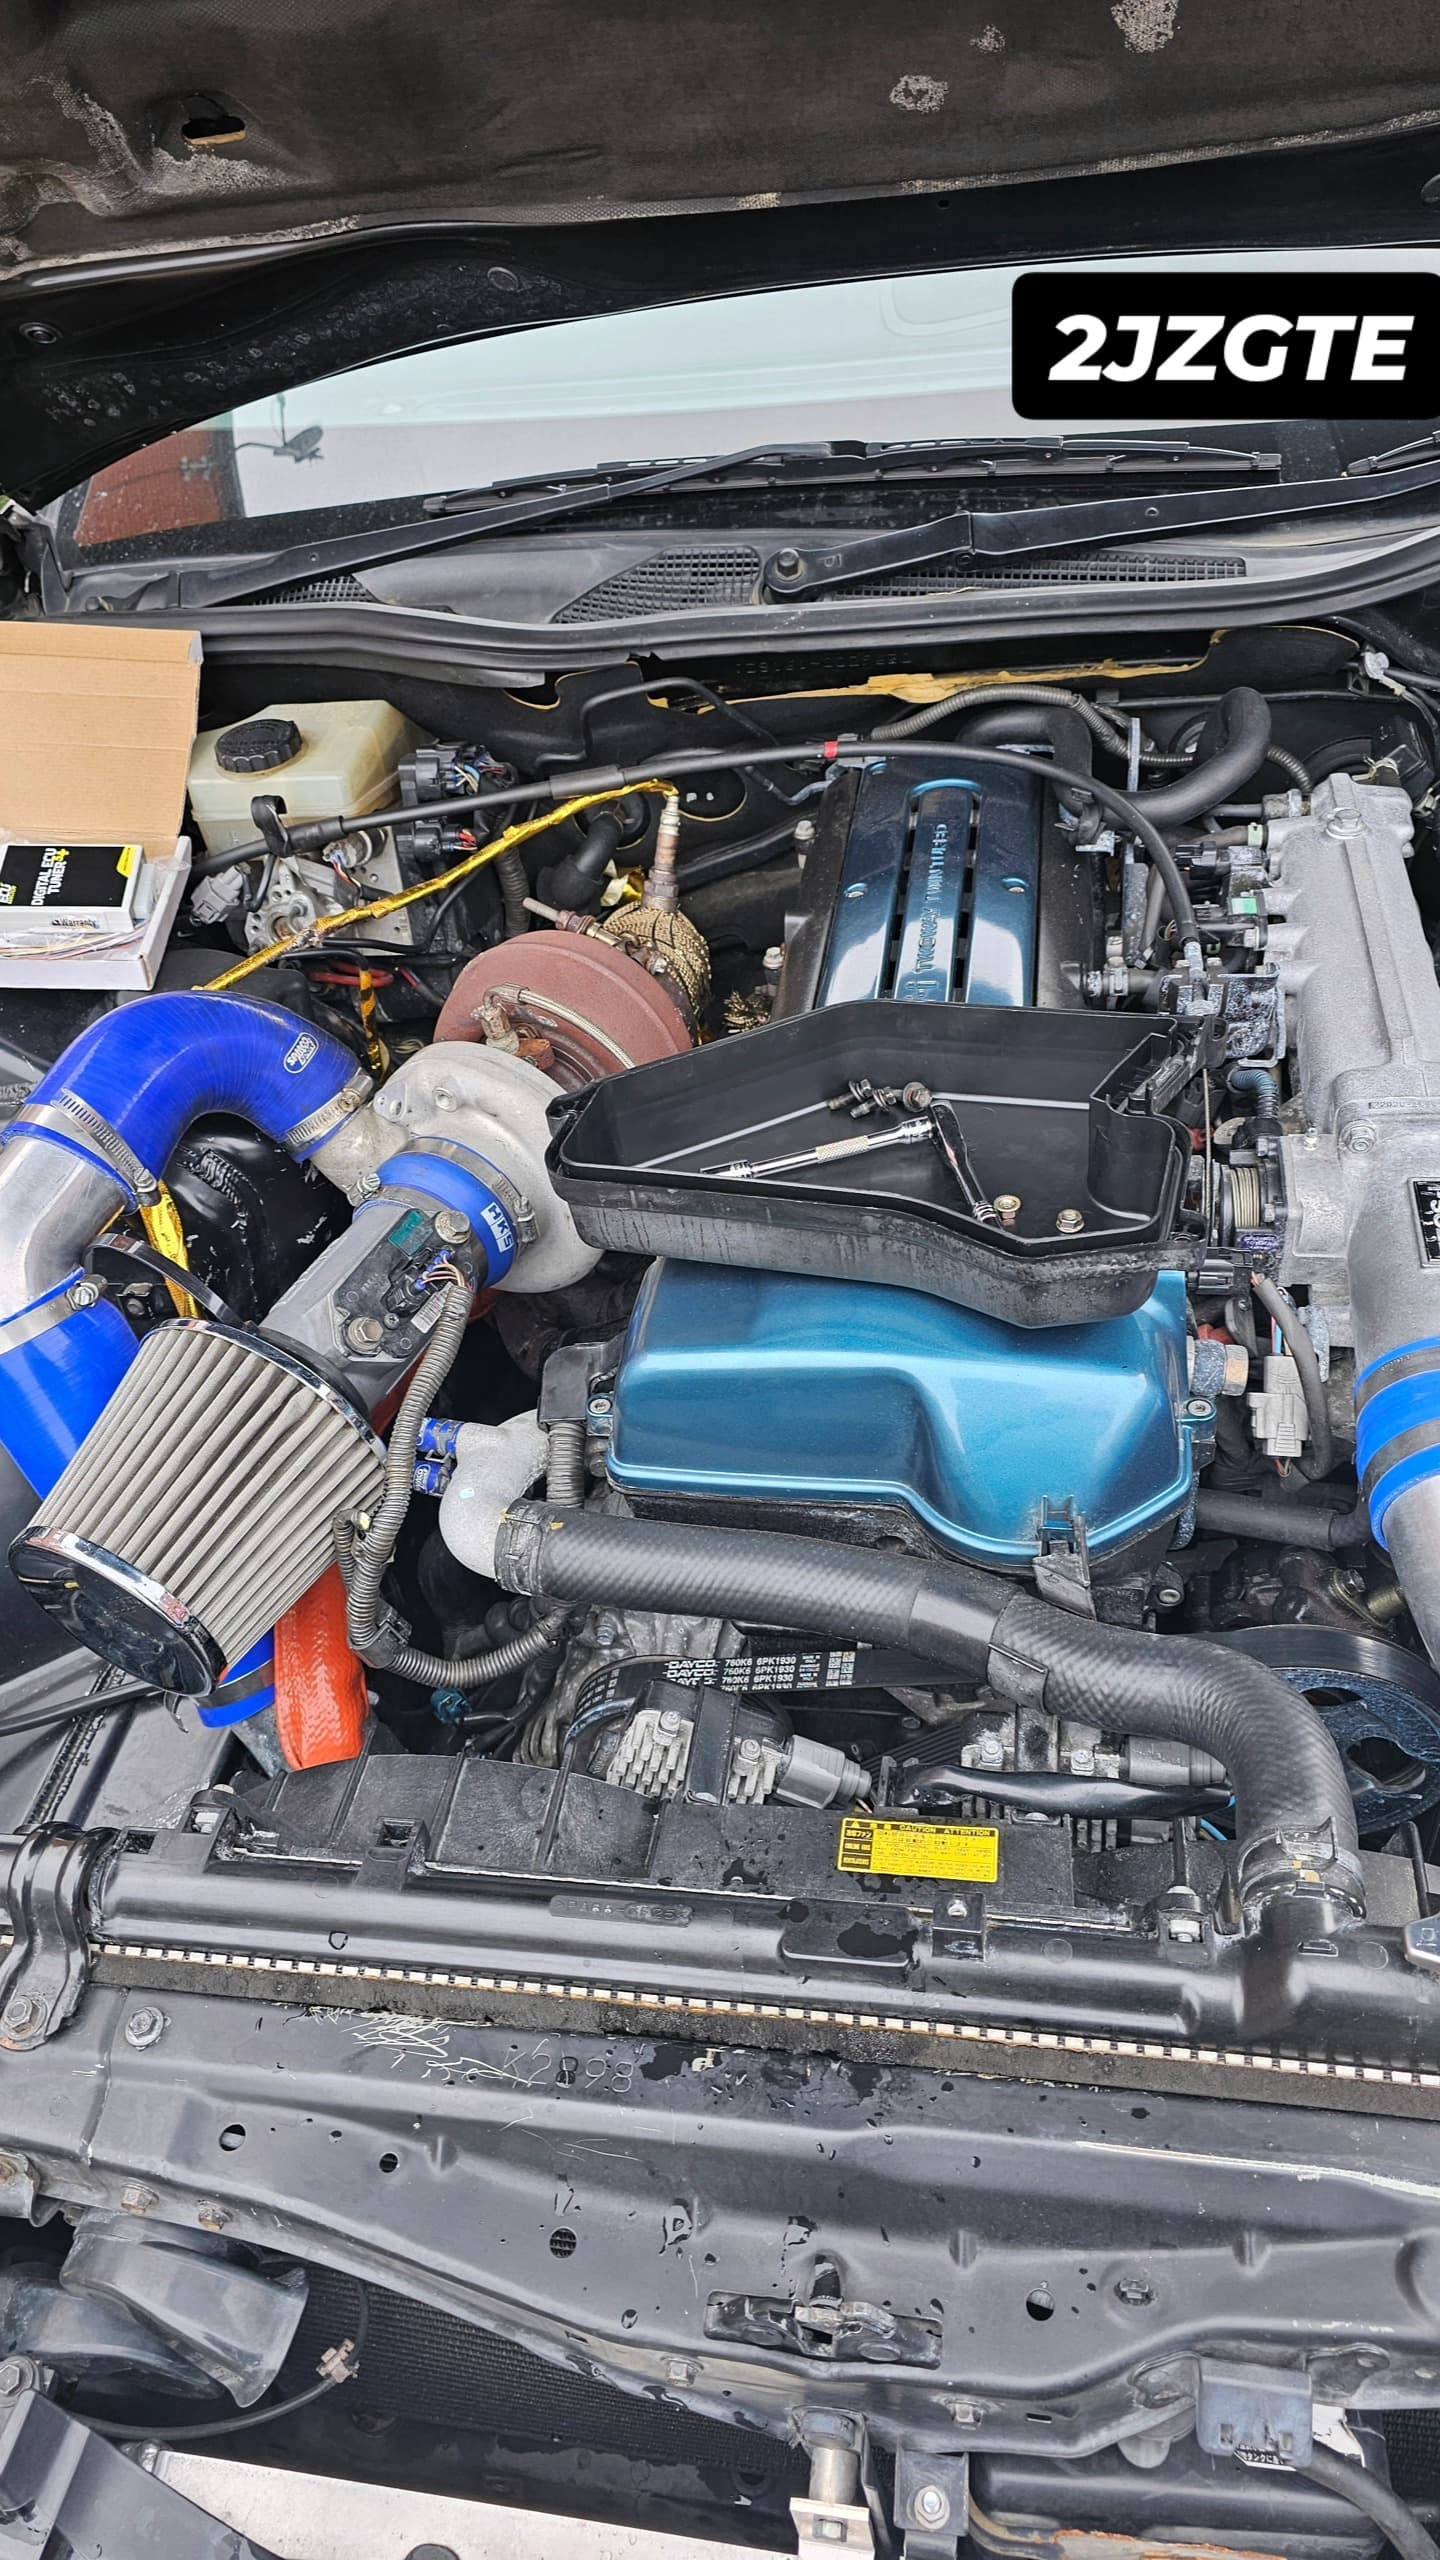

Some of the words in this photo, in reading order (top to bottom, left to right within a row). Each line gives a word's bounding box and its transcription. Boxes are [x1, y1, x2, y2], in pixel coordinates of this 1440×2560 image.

[41, 847, 57, 868] ECU
[47, 861, 68, 894] TUNER
[31, 868, 53, 906] DIGITAL
[484, 1203, 514, 1250] HKS
[662, 1669, 718, 1678] DAYCO
[755, 1665, 795, 1674] 6PK1930
[665, 1660, 719, 1669] DAYCO
[757, 1657, 796, 1666] 6PK1930
[753, 1674, 793, 1683] 6PK1930
[899, 1825, 936, 1833] CAUTION
[943, 1828, 990, 1836] ATTENTION
